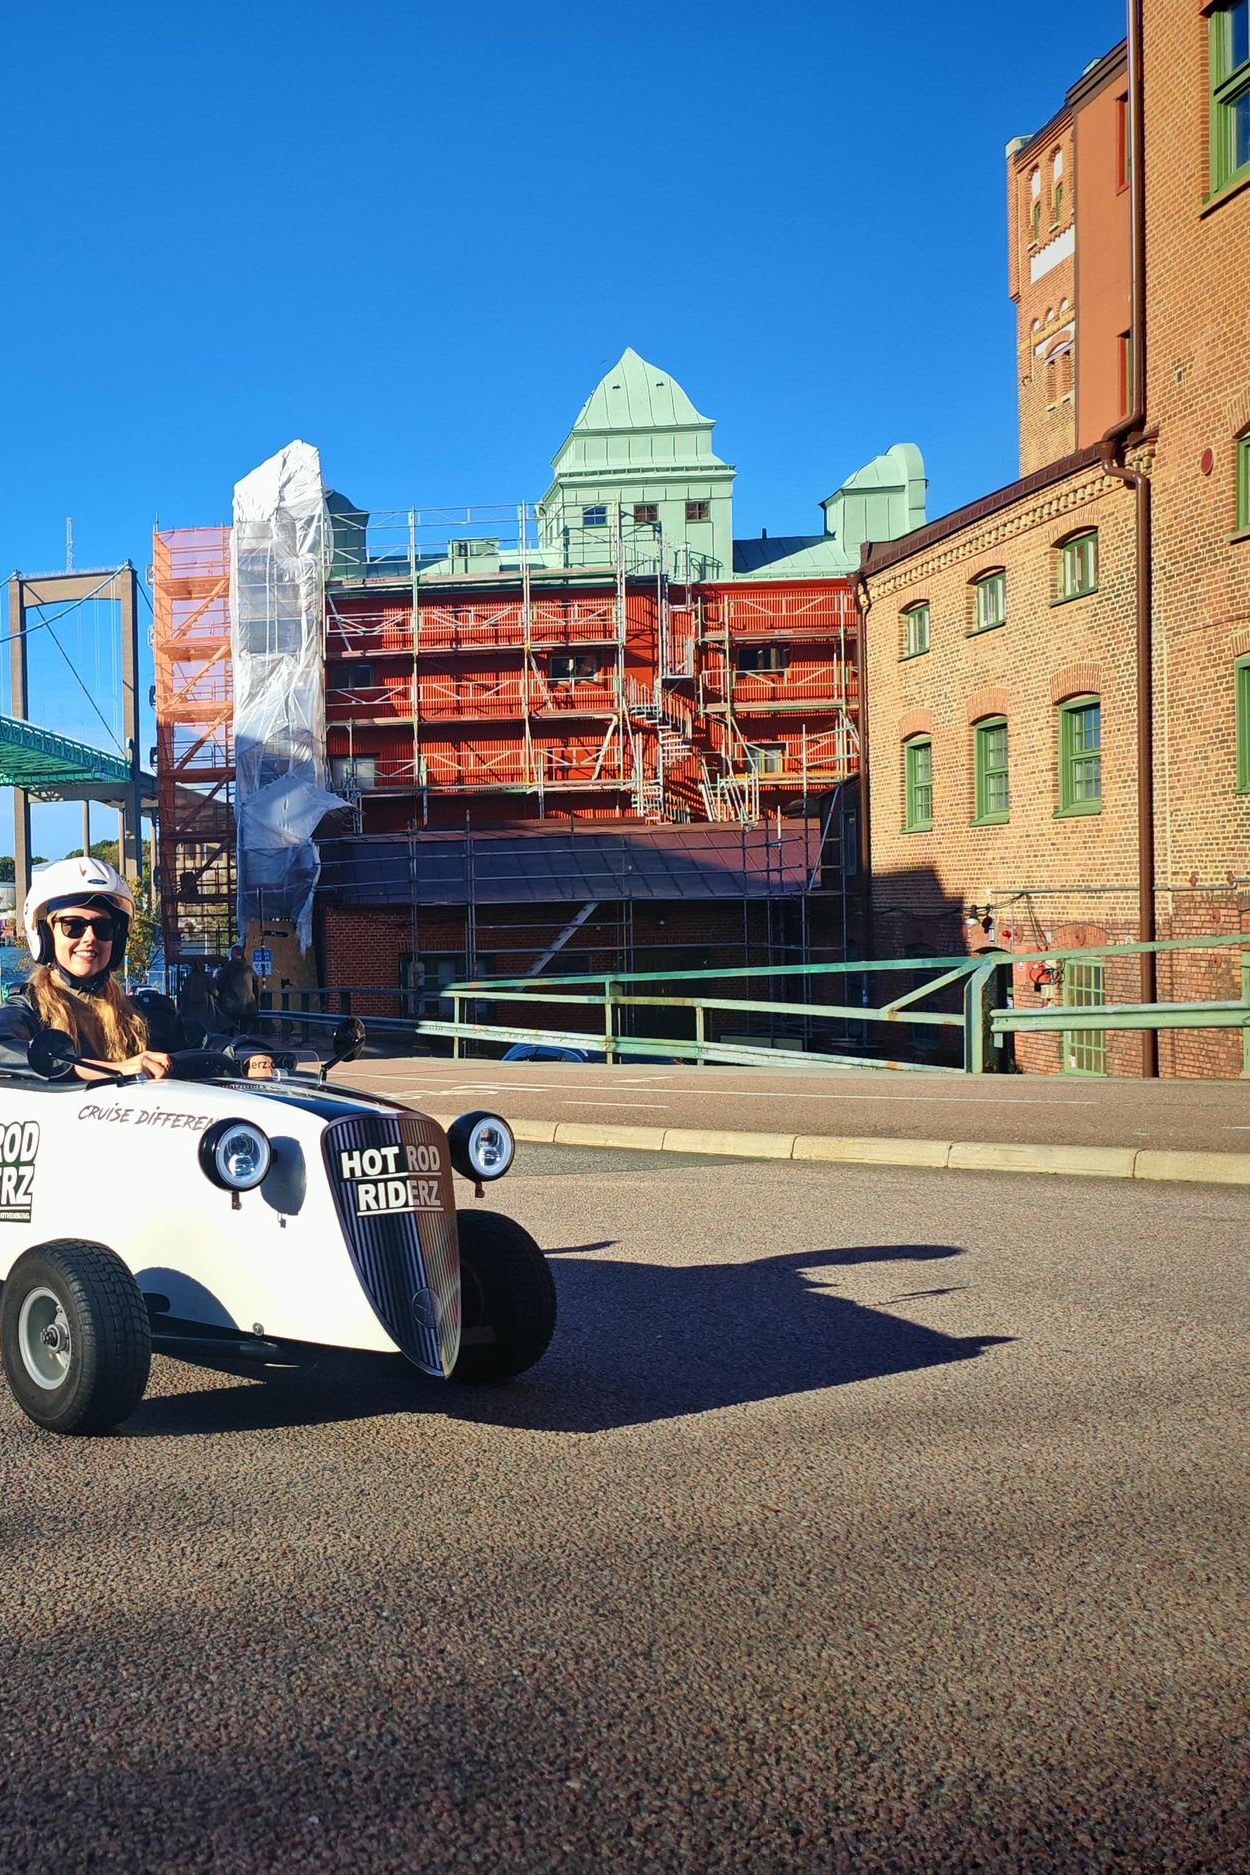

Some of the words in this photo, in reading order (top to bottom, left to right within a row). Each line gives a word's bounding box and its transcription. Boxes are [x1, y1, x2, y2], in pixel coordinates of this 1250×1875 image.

[78, 1103, 134, 1123] CRUISE
[134, 1106, 219, 1131] DIFFEREN
[341, 1146, 400, 1179] HOT
[406, 1145, 441, 1171] ROD
[357, 1180, 442, 1211] RIDERZ
